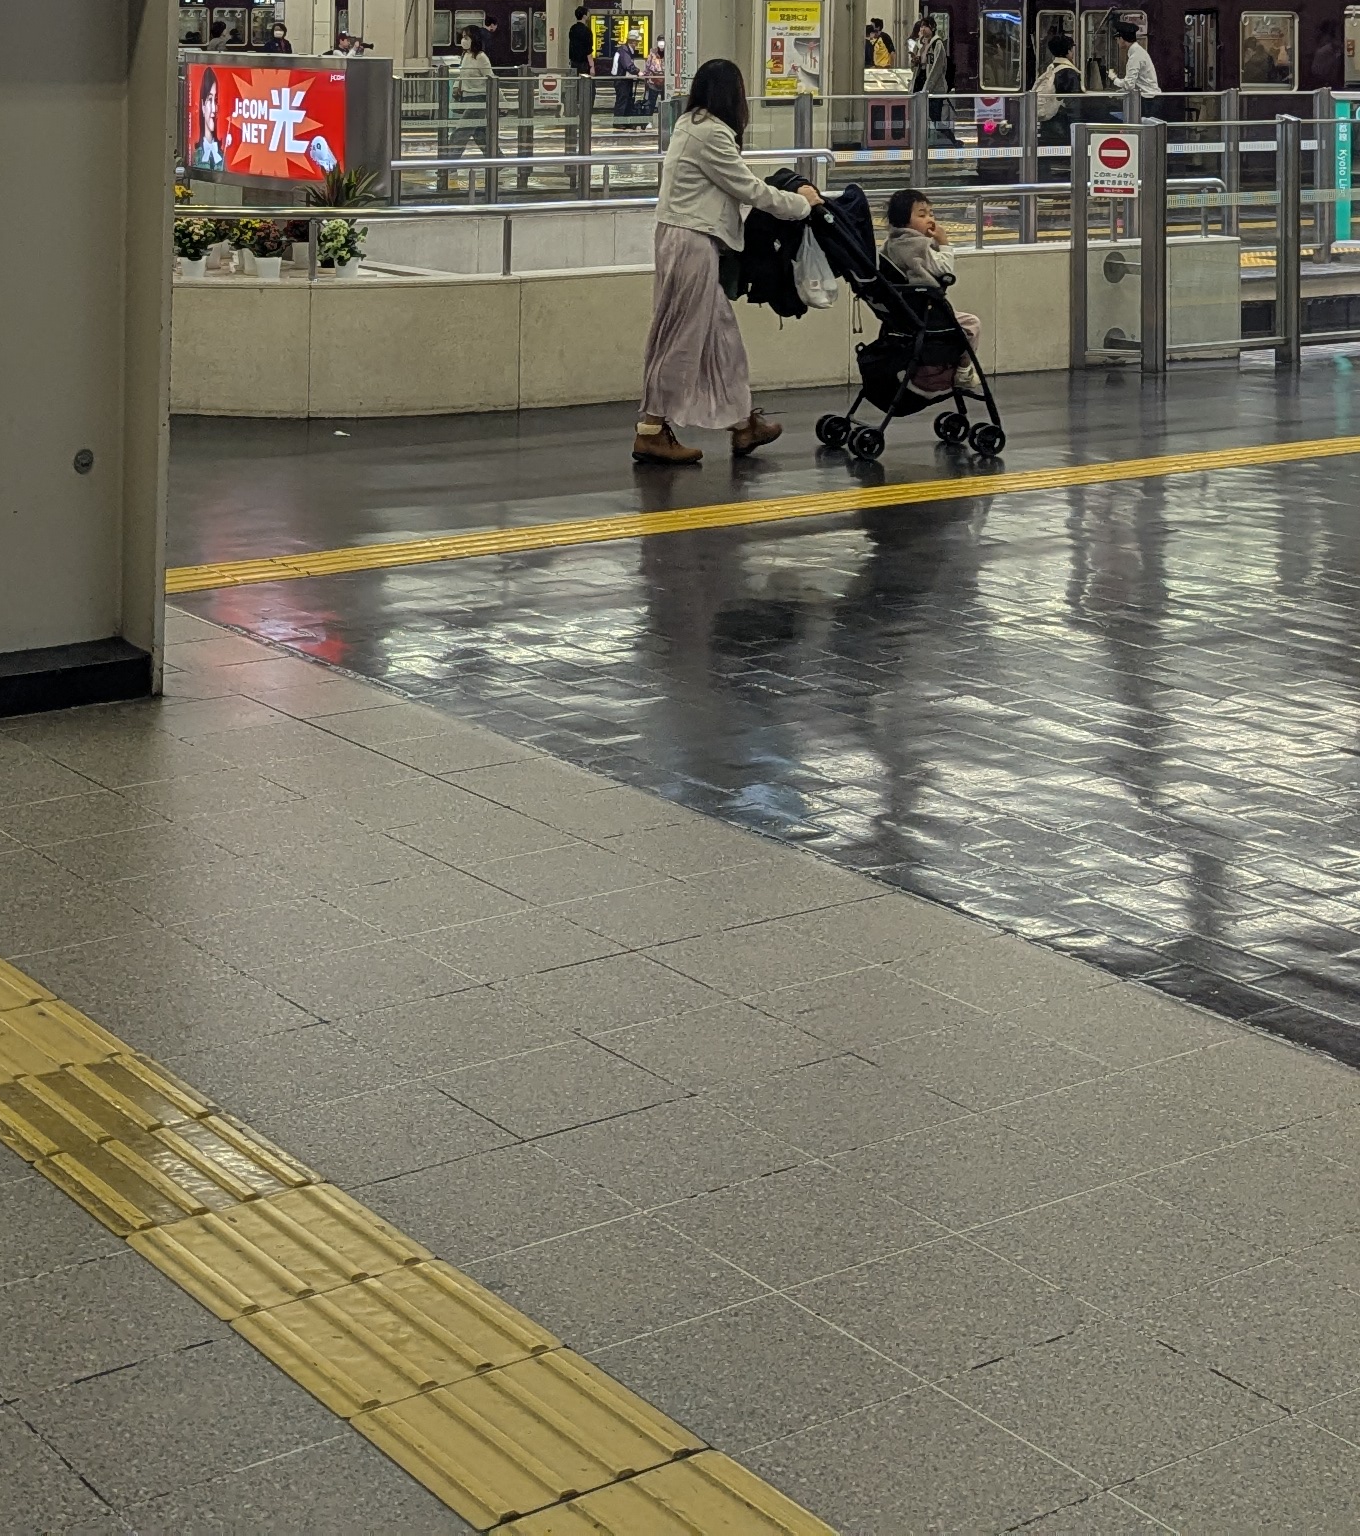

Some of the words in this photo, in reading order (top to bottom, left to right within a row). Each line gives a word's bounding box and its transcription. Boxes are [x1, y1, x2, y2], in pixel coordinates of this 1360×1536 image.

[231, 97, 268, 121] J:COM
[268, 87, 311, 154] 光
[241, 122, 268, 145] NET
[1336, 149, 1348, 176] Kyoto
